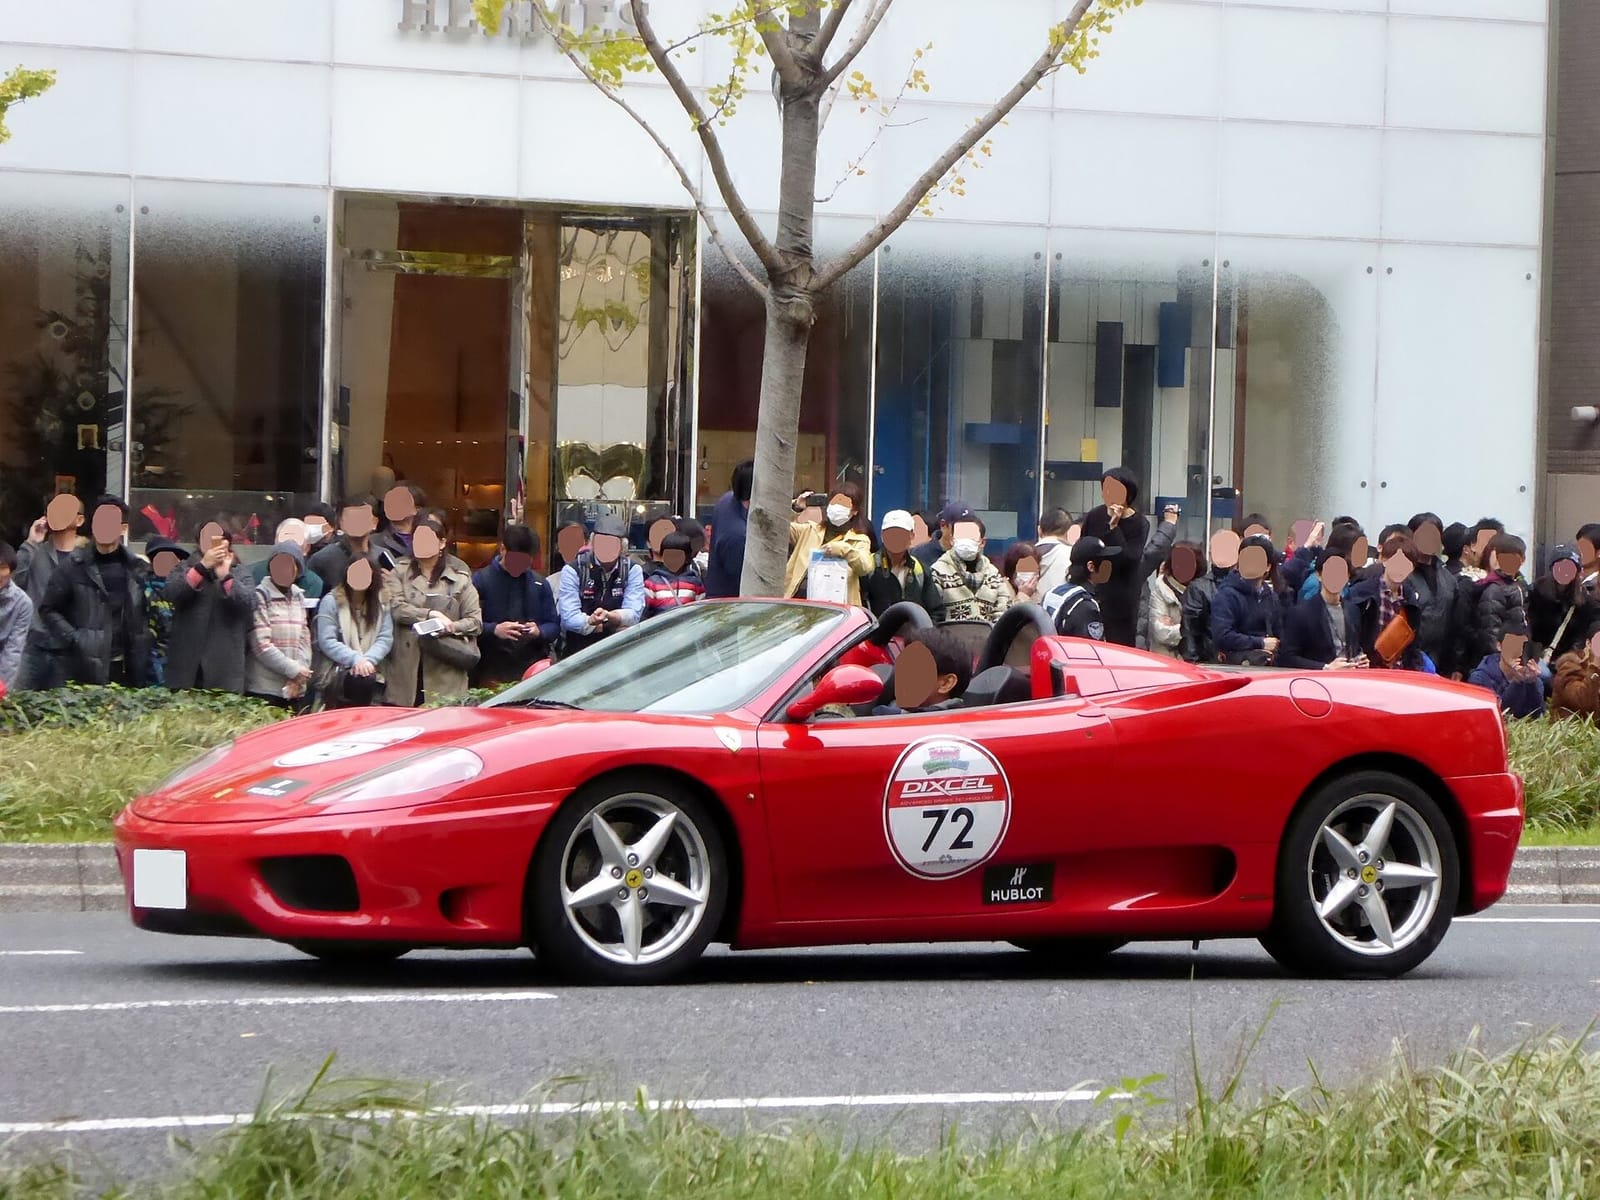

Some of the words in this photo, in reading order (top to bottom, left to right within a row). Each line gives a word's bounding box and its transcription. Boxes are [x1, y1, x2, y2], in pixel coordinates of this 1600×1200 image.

[902, 777, 993, 796] DIXCEL
[921, 807, 974, 853] 72
[991, 887, 1044, 901] HUBLOT
